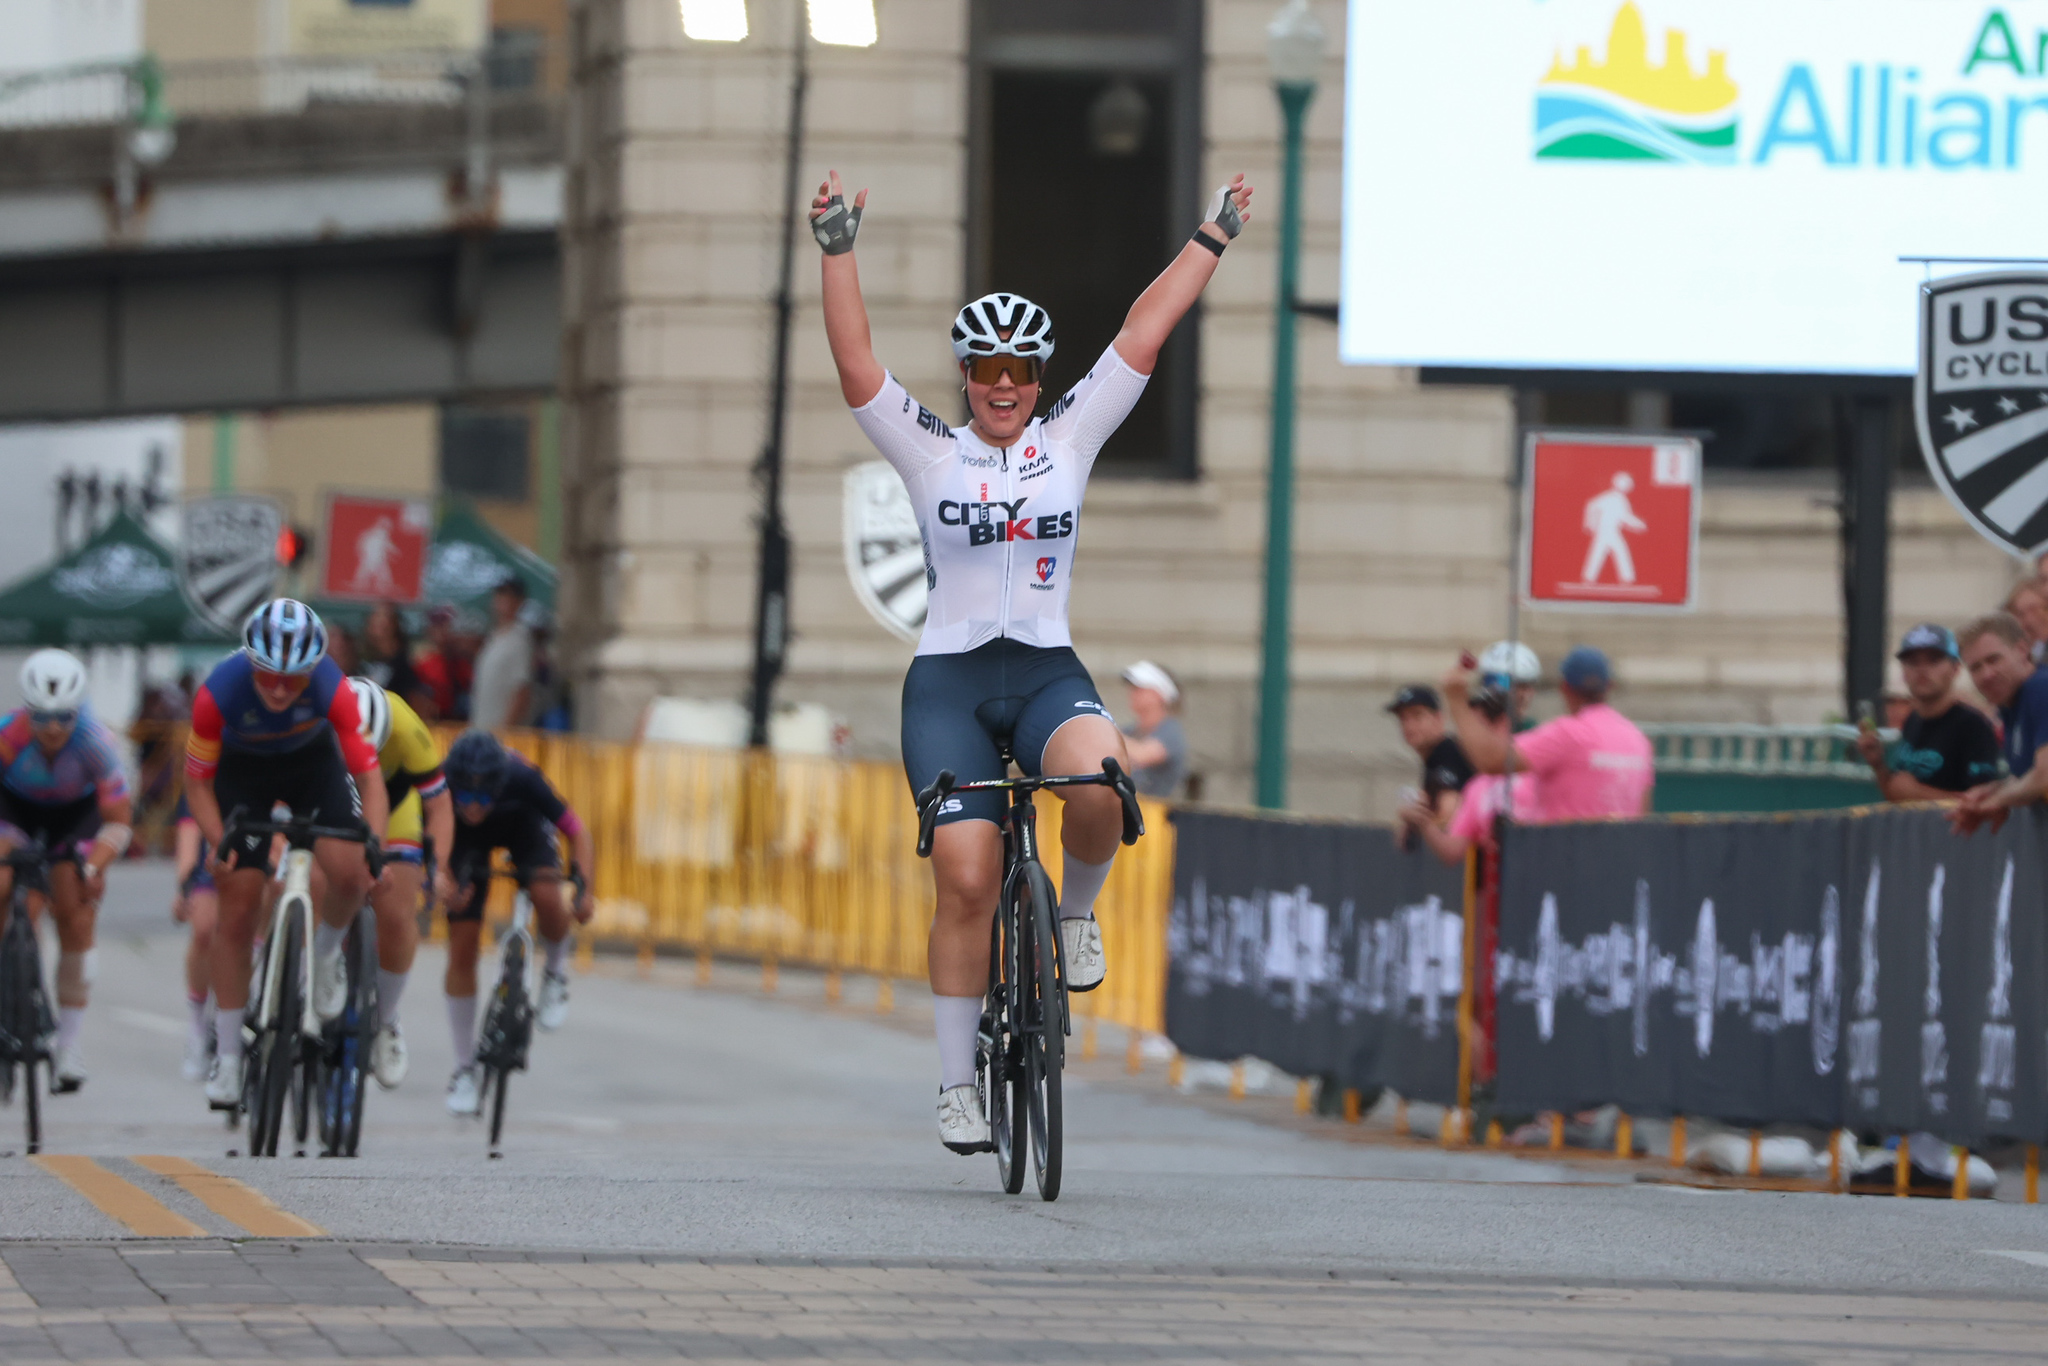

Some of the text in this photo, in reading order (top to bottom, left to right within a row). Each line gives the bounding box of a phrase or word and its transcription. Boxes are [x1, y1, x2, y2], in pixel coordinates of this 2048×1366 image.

[1947, 351, 2048, 380] CYCL
[1018, 452, 1050, 474] KASK
[938, 497, 1028, 526] CITY
[969, 511, 1073, 547] BIKES
[969, 778, 1005, 786] LOOK
